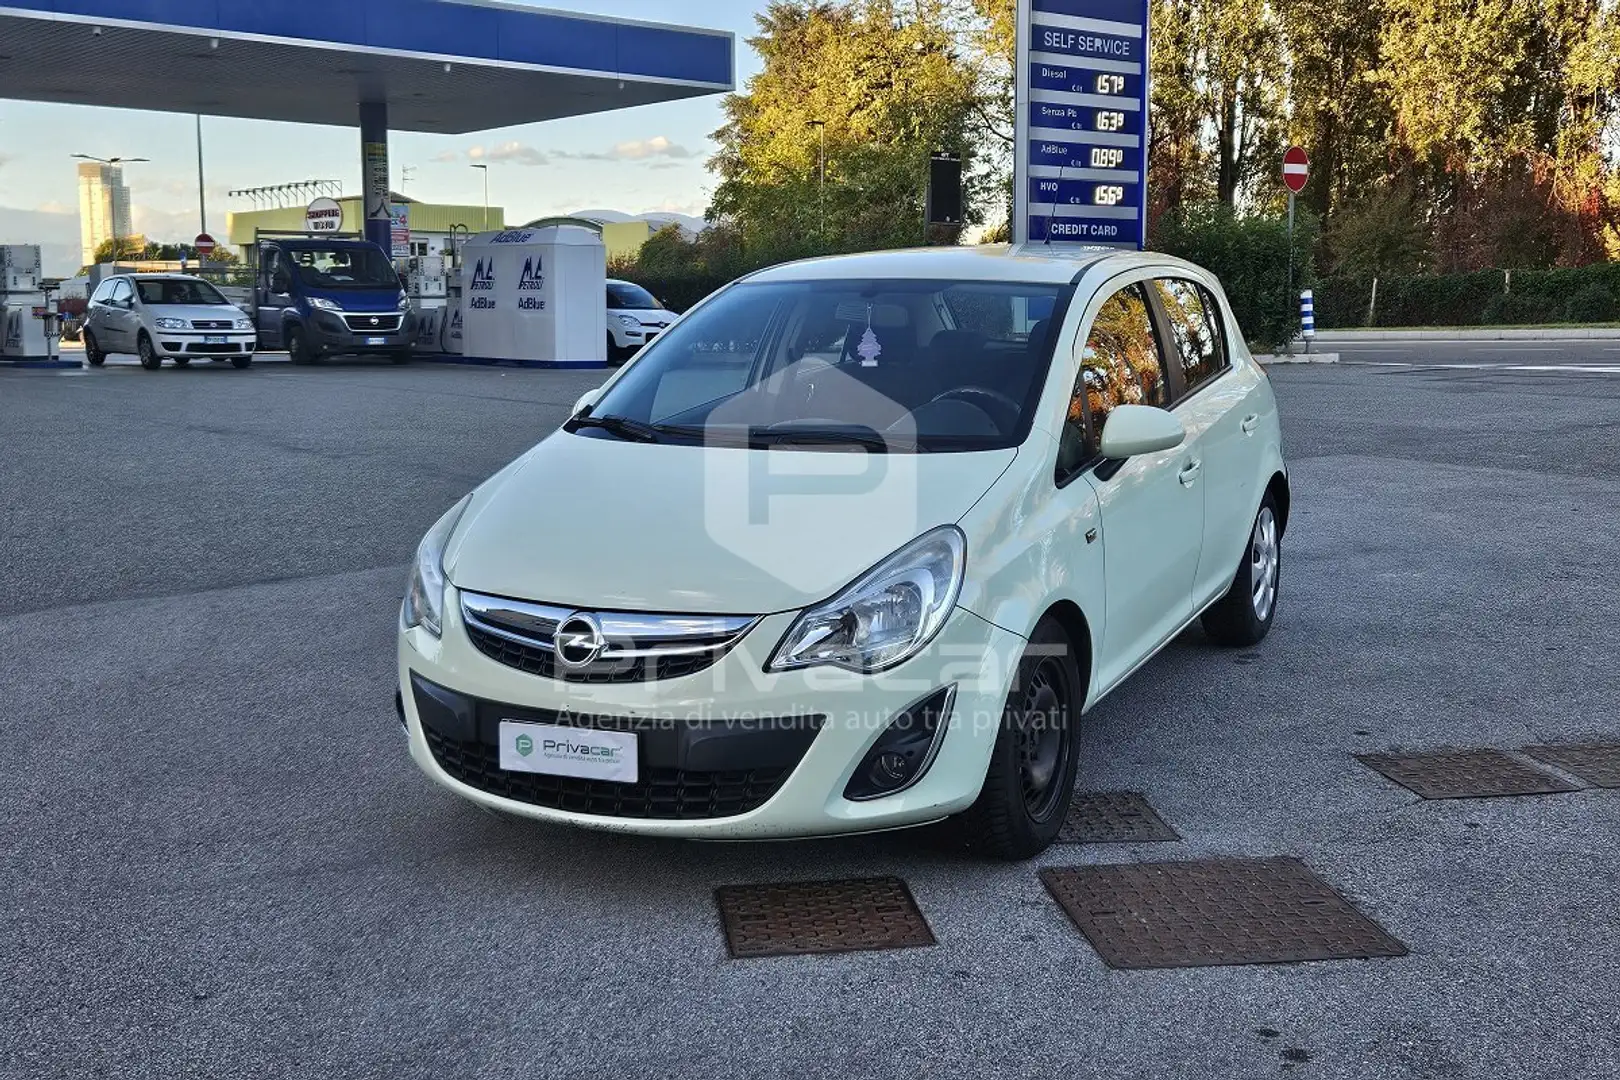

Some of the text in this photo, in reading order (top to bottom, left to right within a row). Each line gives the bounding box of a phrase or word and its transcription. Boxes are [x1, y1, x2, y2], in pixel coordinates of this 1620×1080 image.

[1043, 31, 1130, 56] SELF SERVICE
[1042, 67, 1067, 79] Diesel
[1041, 106, 1065, 116] Senza
[1040, 144, 1068, 155] AdBlue
[1040, 182, 1059, 192] HVO
[1051, 223, 1118, 236] CREDIT CARD
[489, 231, 533, 243] AdBlue
[470, 297, 495, 309] AdBlue
[518, 297, 545, 310] AdBlue
[543, 739, 621, 757] Privacar
